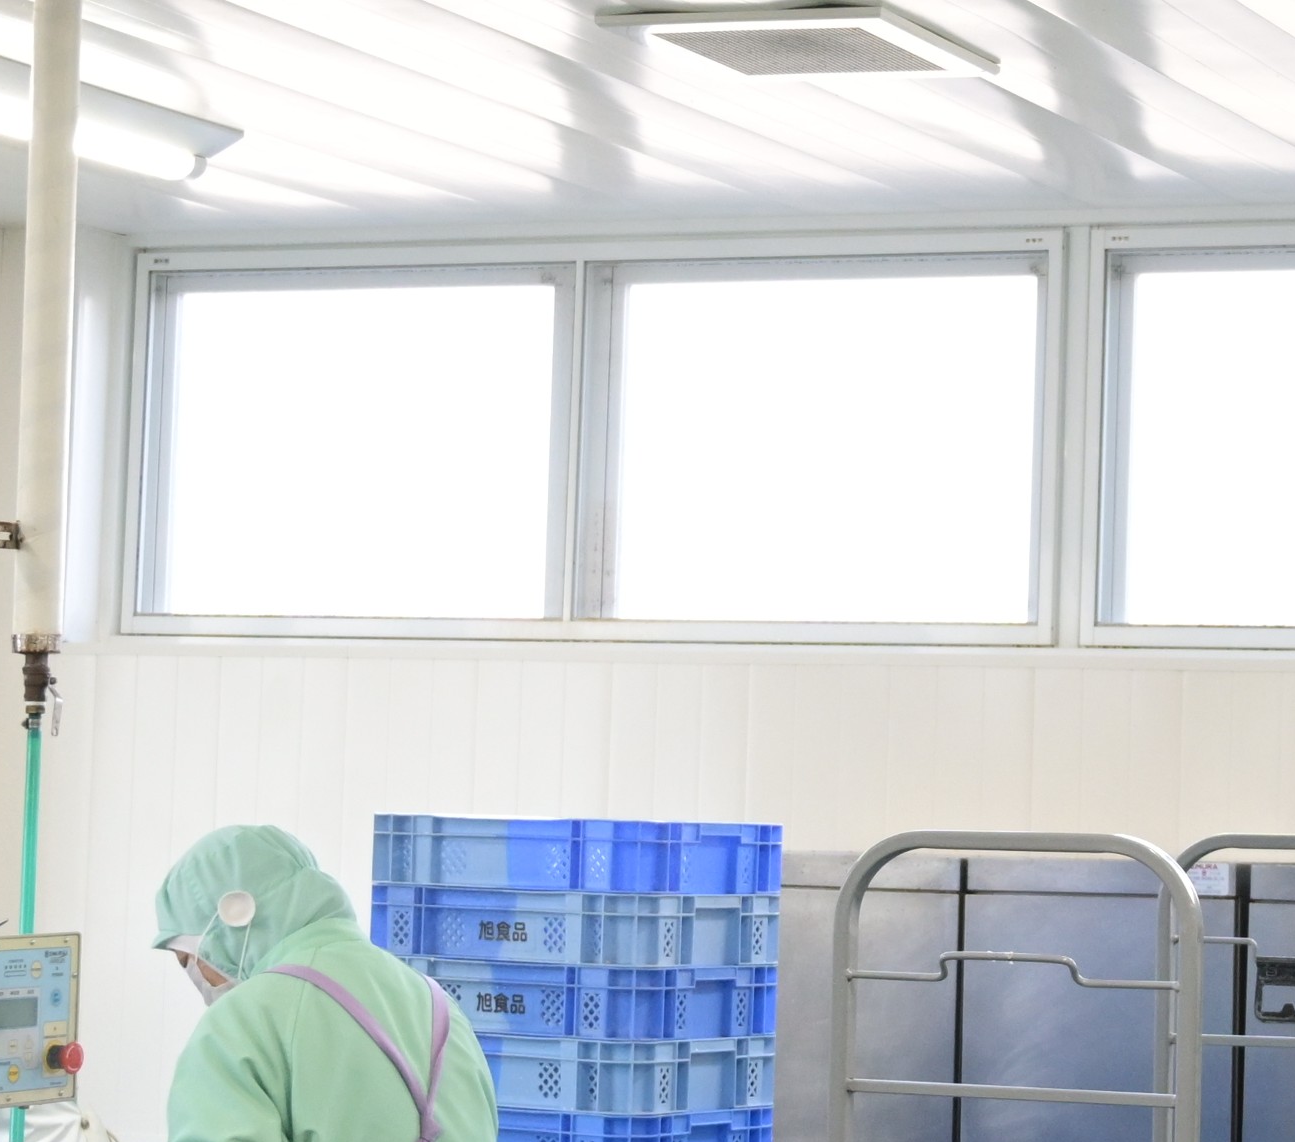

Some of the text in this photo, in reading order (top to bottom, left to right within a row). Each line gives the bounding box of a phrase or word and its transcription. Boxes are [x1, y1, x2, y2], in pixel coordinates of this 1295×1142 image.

[479, 919, 527, 942] 旭食品
[476, 991, 526, 1015] 旭食品
